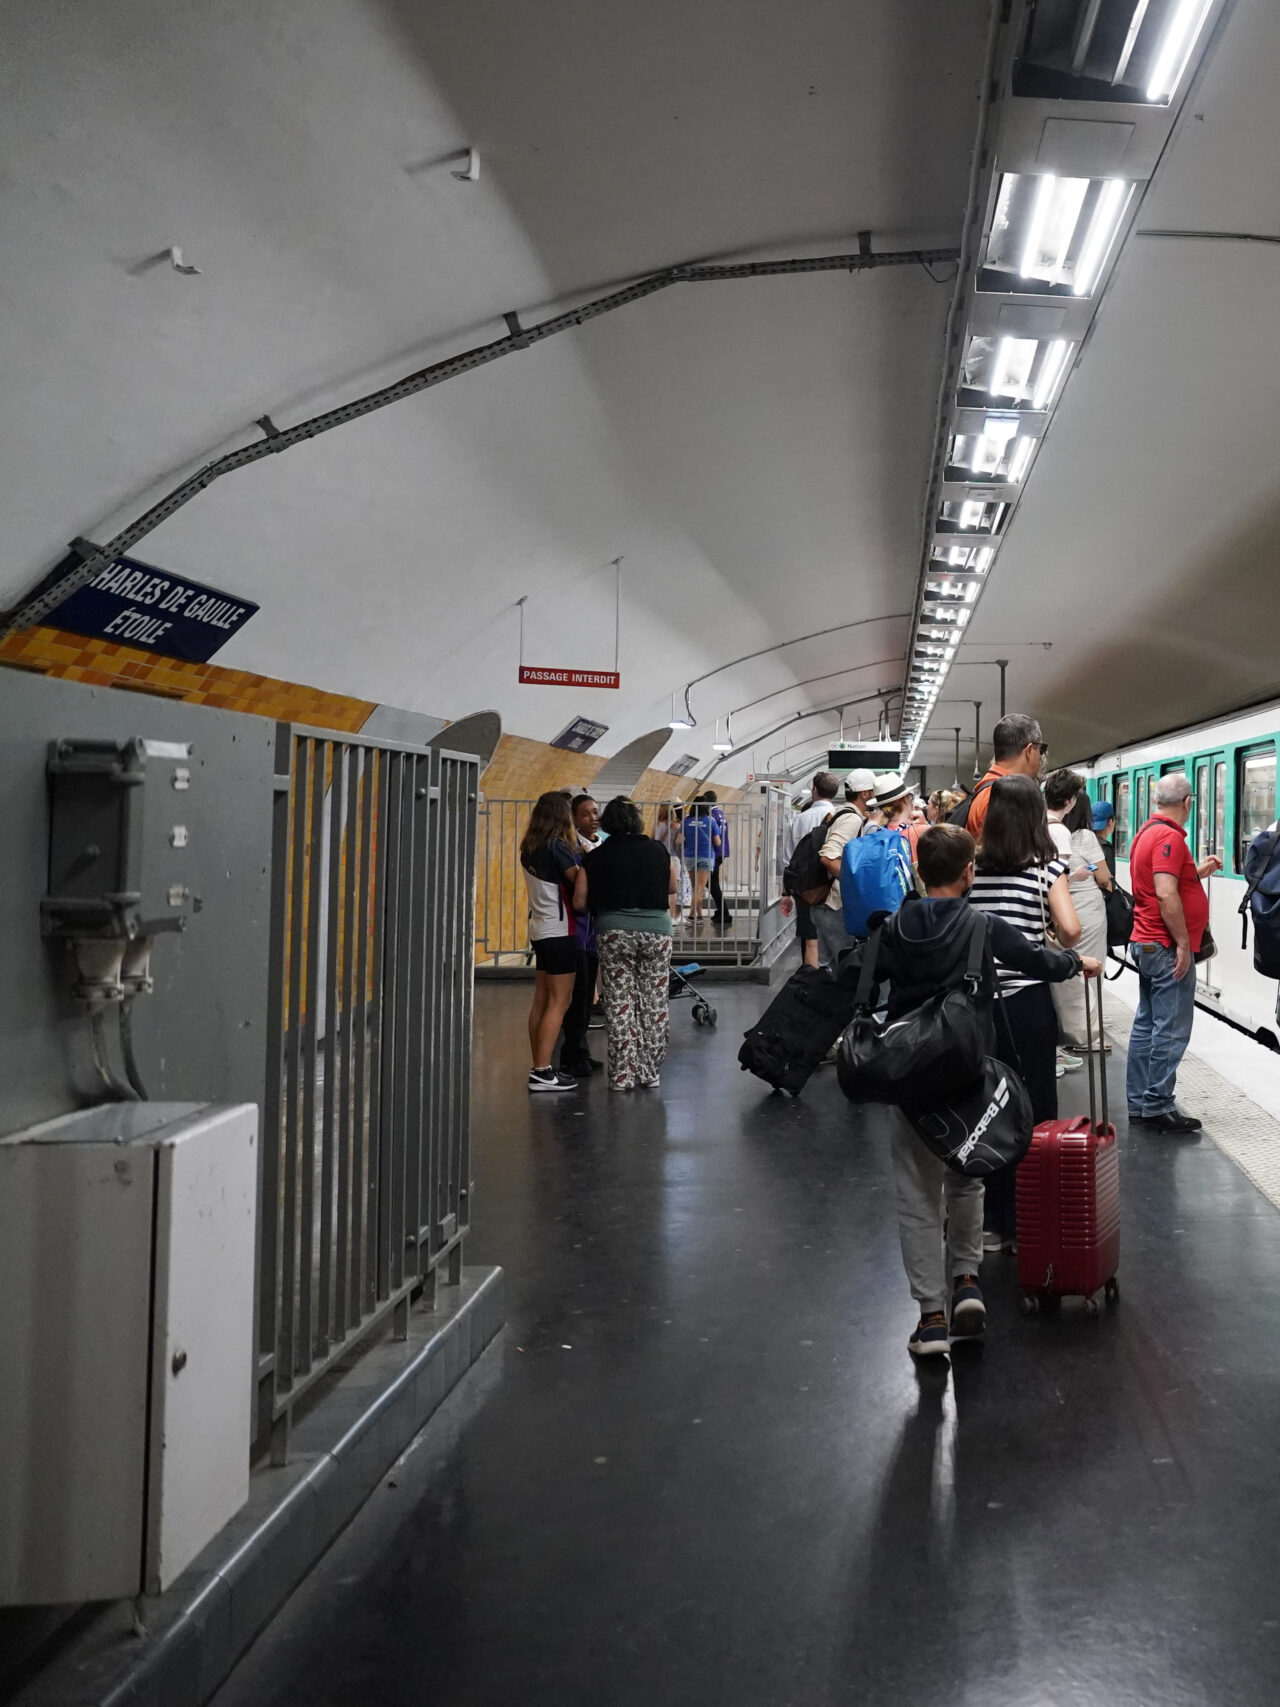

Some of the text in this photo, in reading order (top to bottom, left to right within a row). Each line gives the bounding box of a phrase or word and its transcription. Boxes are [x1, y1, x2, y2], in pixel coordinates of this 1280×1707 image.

[87, 563, 245, 629] HARLES DE GAULLE
[104, 606, 173, 644] ÉTOILE
[524, 670, 616, 684] PASSAGE INTERDIT
[957, 1102, 1000, 1166] Babolat
